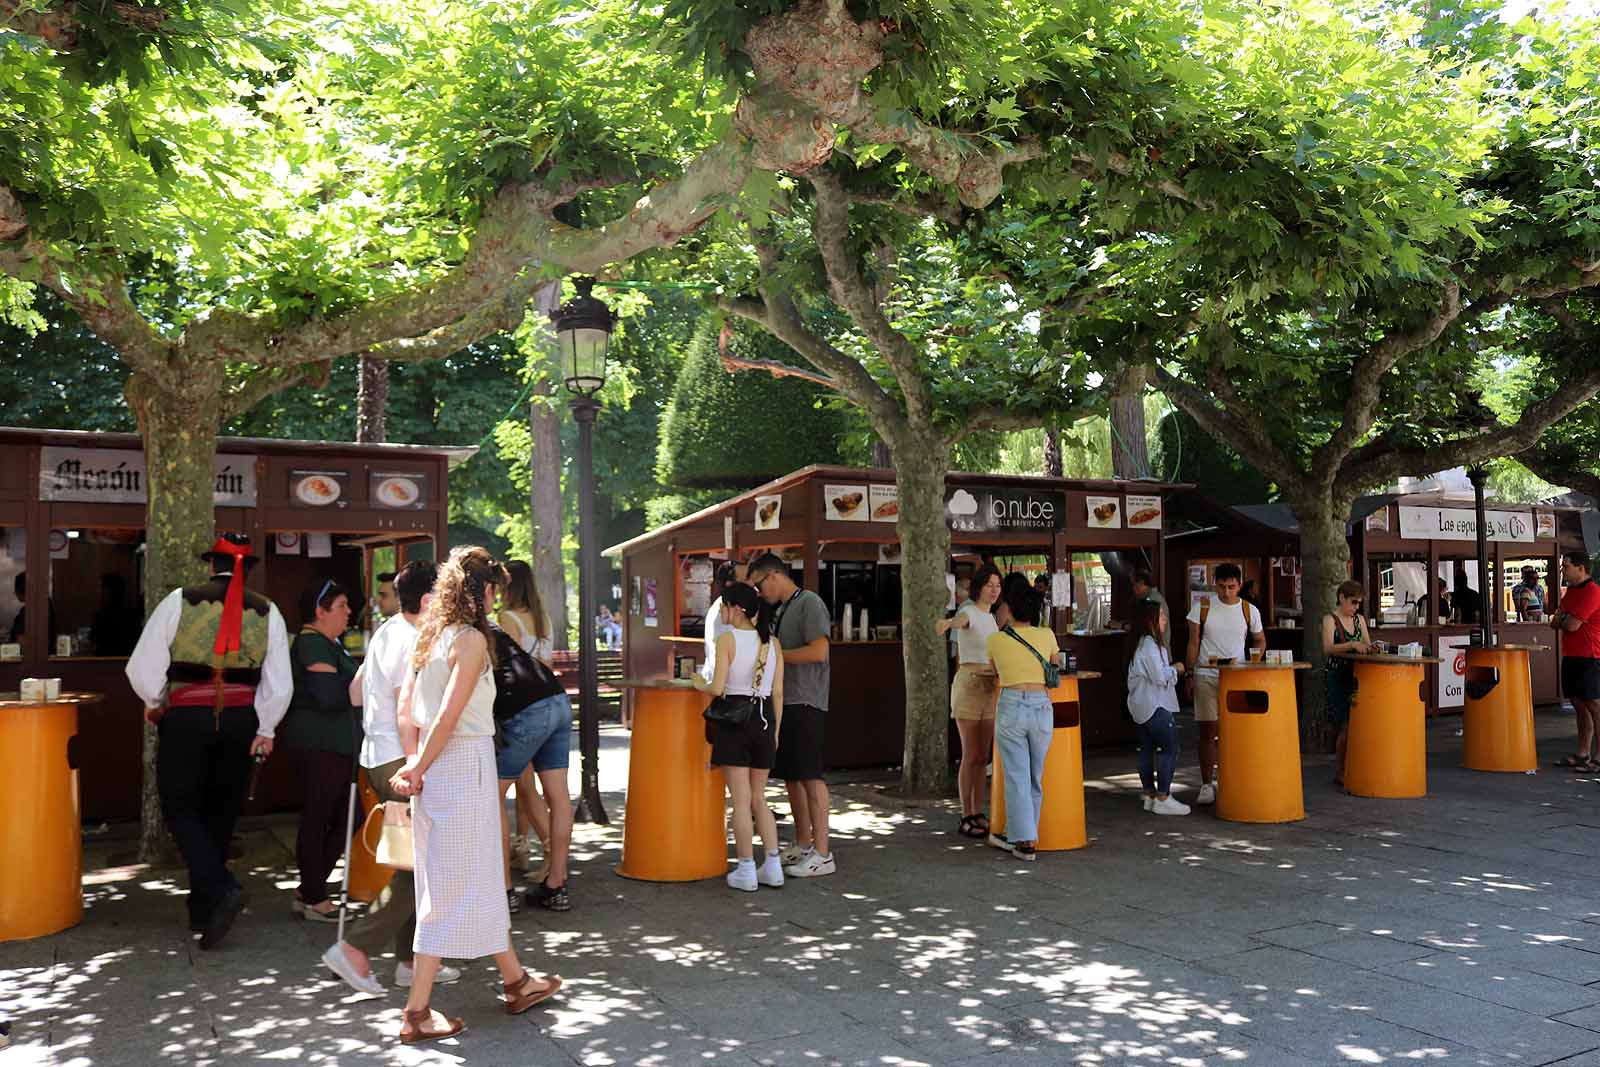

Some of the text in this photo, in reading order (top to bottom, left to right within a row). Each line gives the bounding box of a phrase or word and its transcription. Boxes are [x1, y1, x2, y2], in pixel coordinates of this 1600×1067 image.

[53, 459, 141, 492] Mesón
[990, 494, 1055, 520] la nube
[1438, 511, 1455, 532] Las
[1445, 685, 1462, 697] Con
